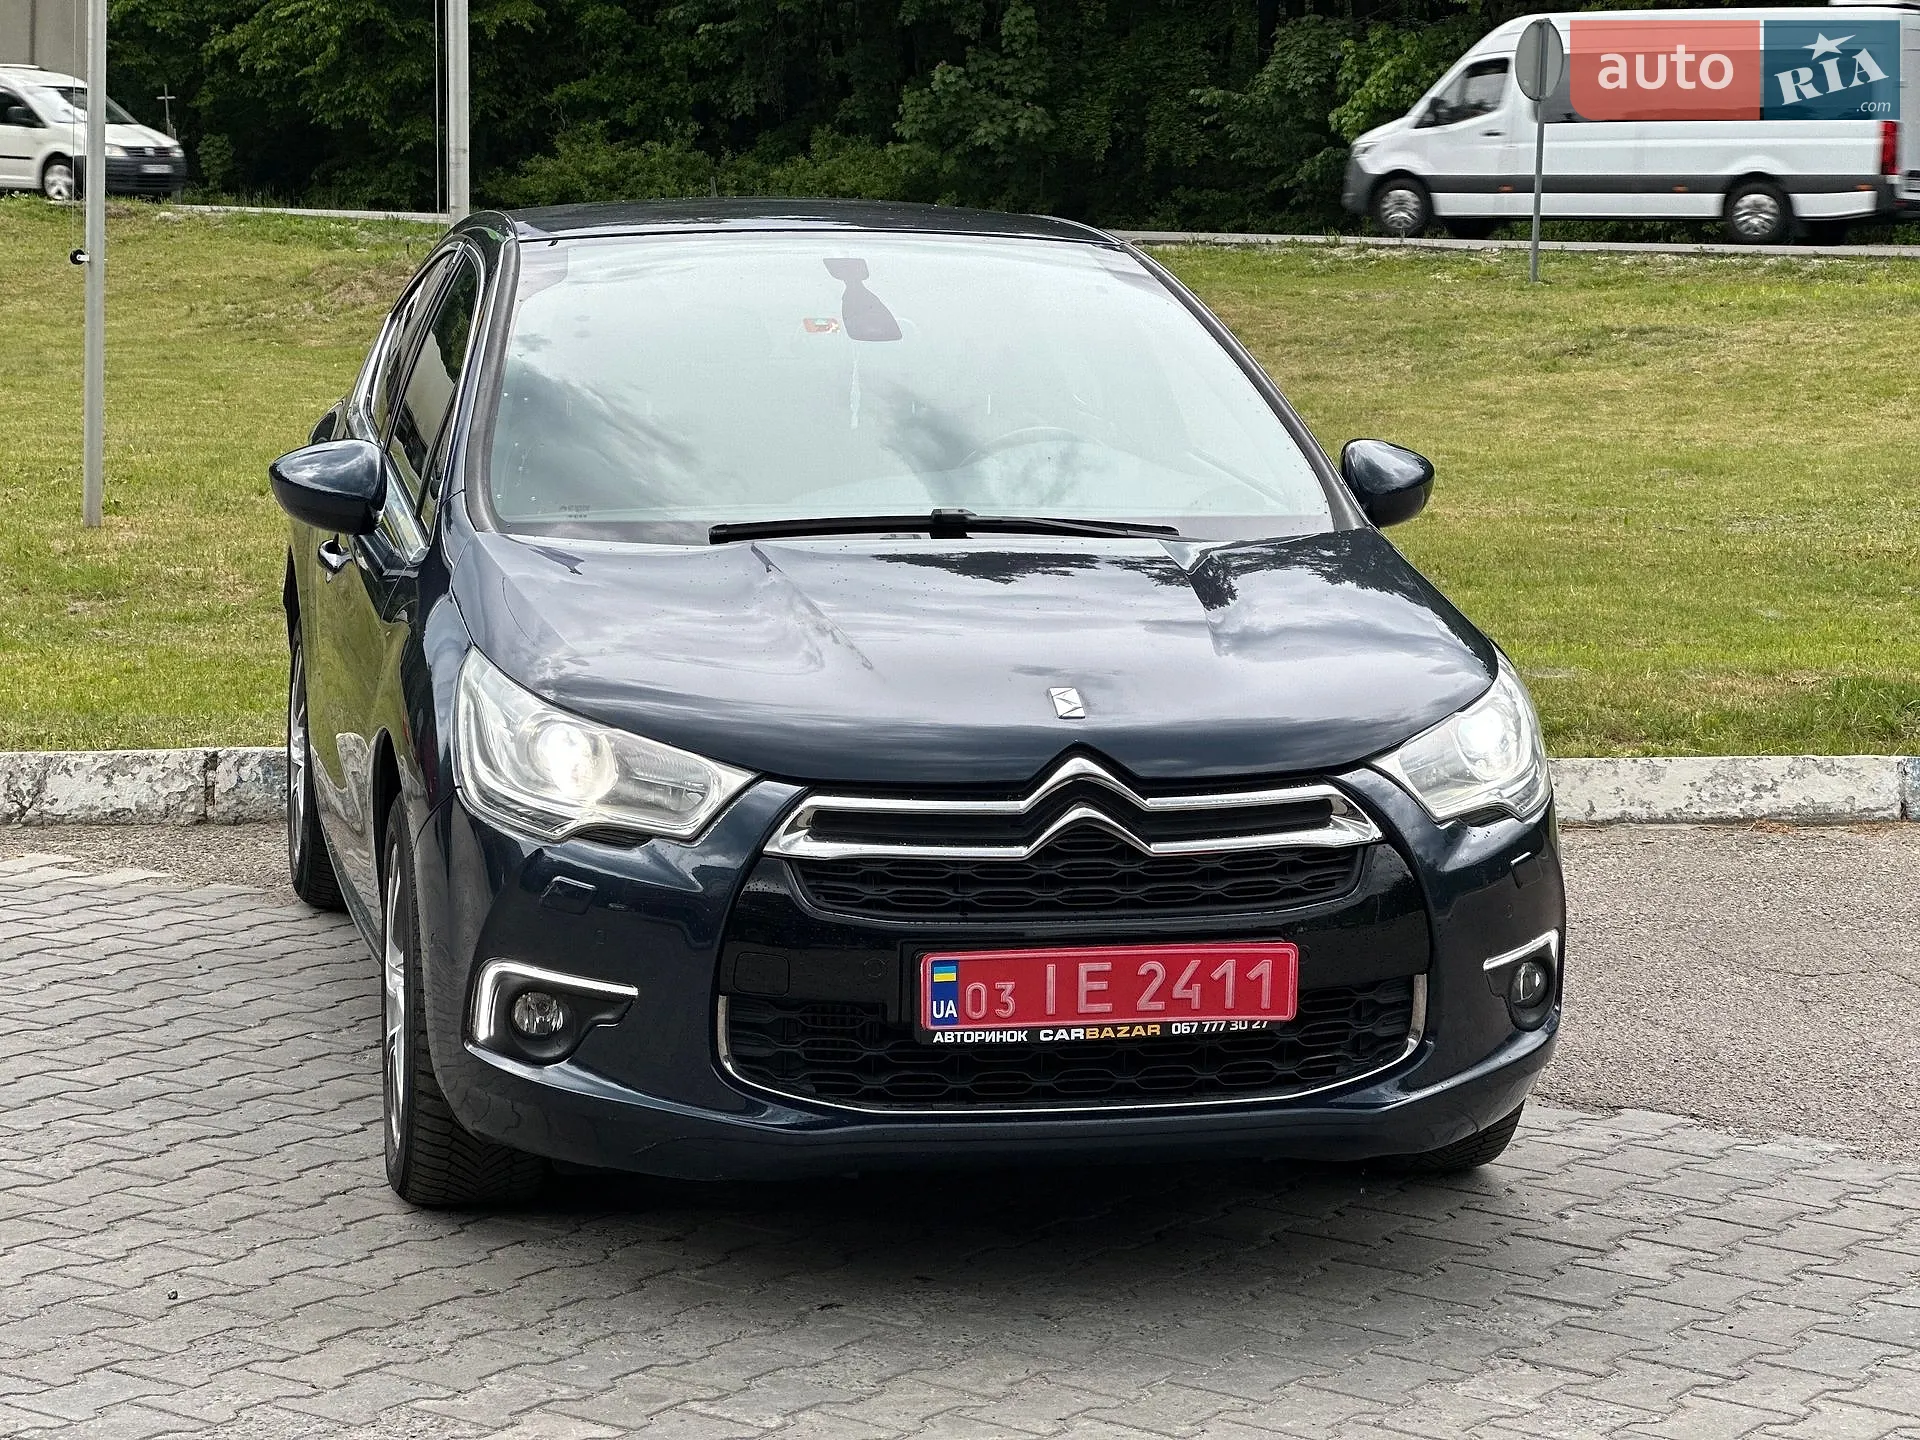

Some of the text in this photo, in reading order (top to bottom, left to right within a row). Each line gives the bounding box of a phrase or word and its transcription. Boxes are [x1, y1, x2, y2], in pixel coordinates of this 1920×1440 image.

[932, 959, 1273, 1019] UA 03 IE 2411
[932, 1030, 1028, 1043] АВТОРИНОК
[1039, 1024, 1161, 1042] CARBAZAR
[1171, 1022, 1198, 1035] 067
[1202, 1021, 1226, 1033] 777
